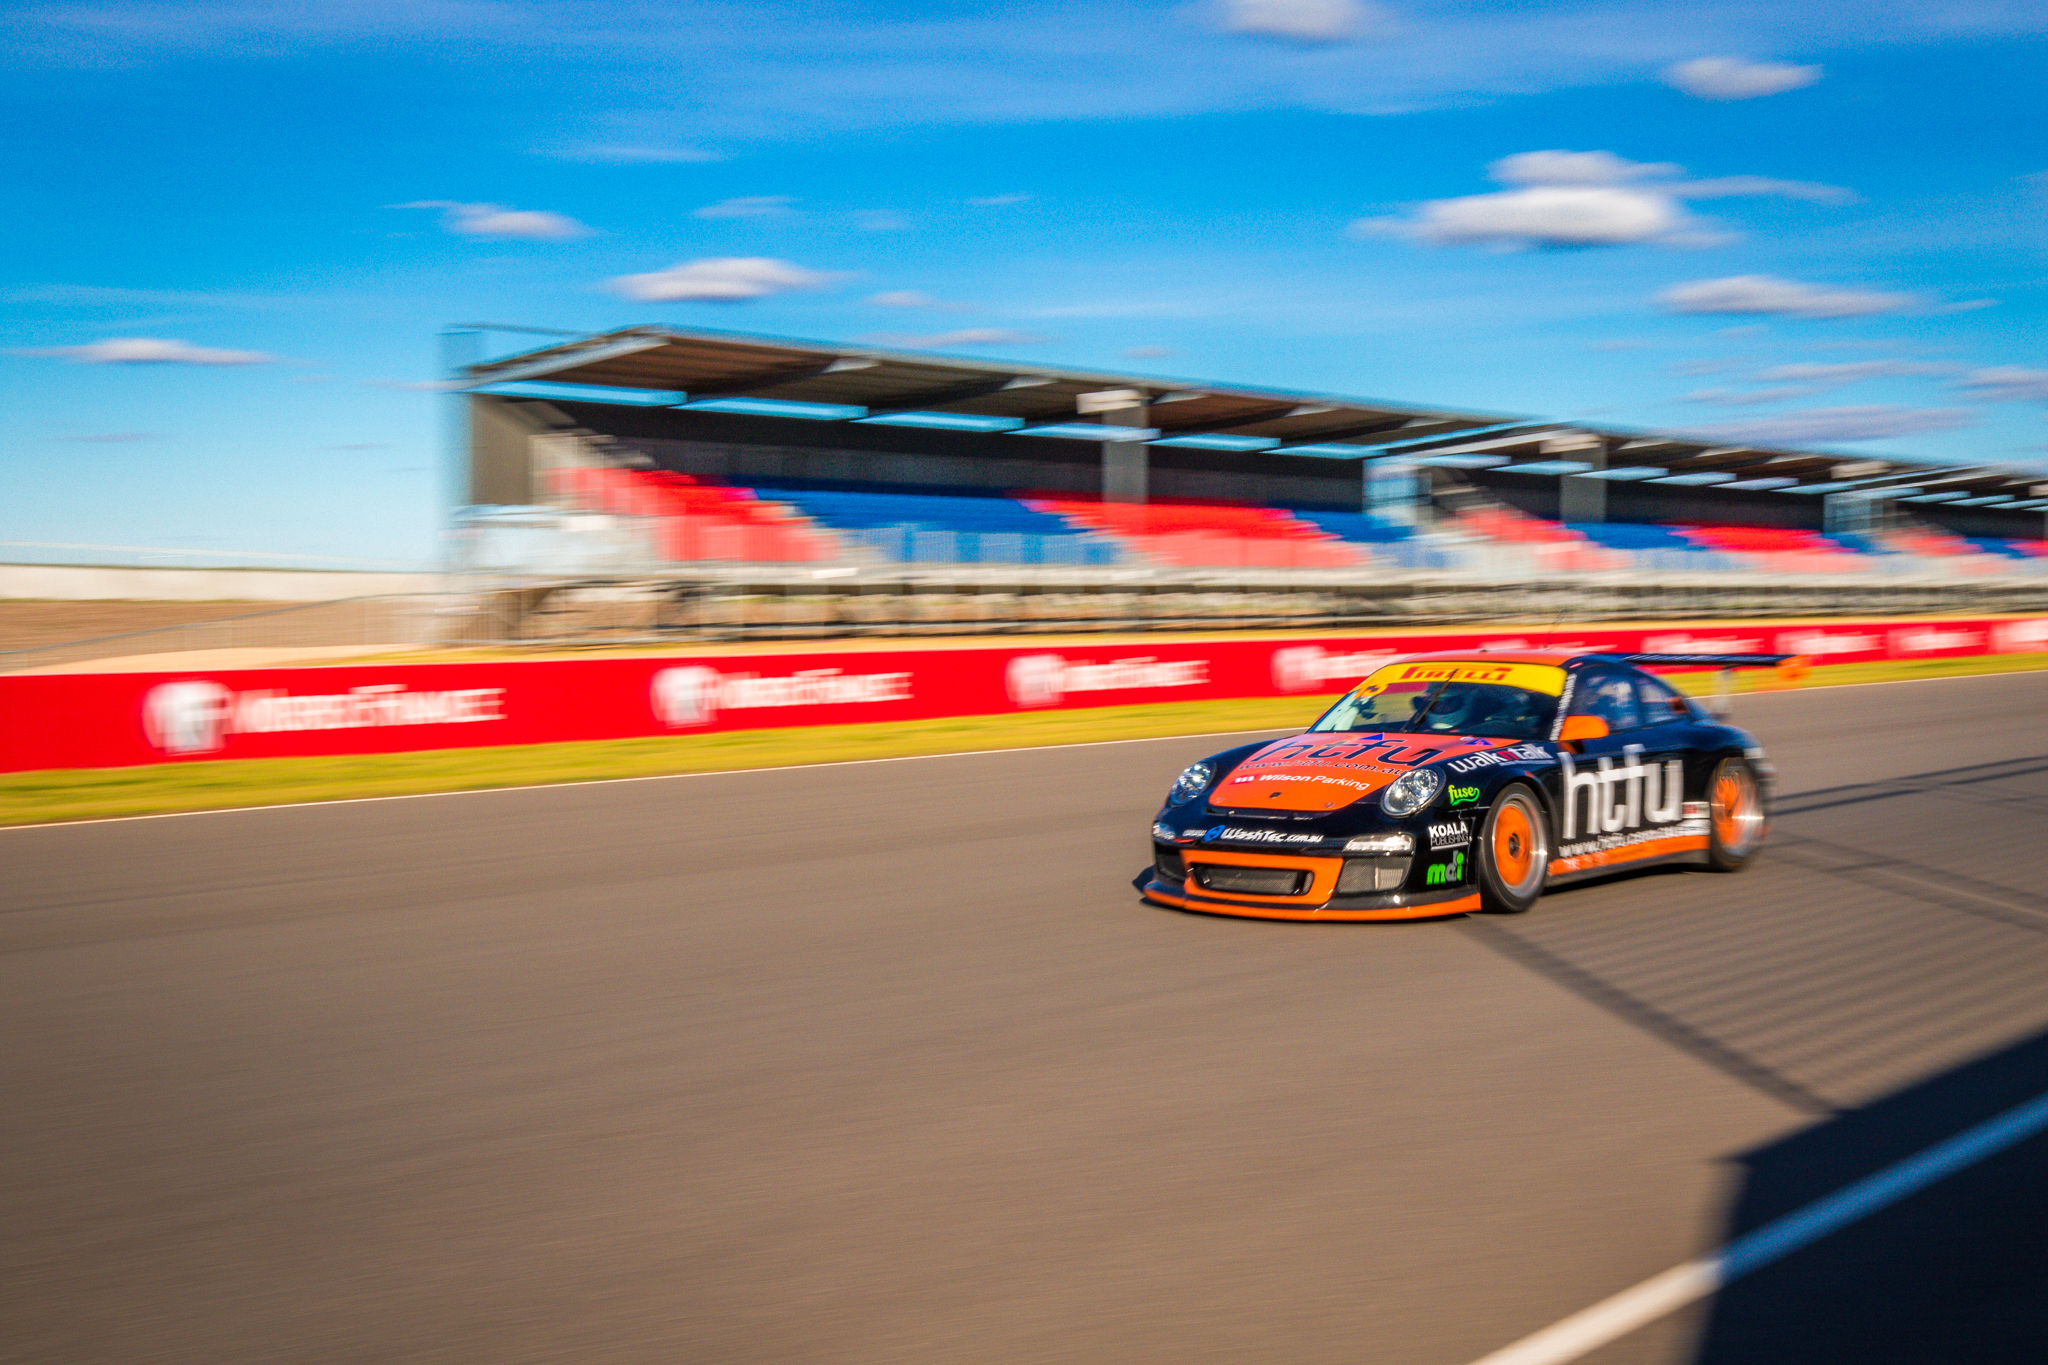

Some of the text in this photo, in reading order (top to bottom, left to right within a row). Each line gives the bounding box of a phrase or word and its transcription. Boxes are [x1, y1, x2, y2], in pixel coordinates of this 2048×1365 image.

[1399, 665, 1514, 682] PIRELLI
[1248, 738, 1446, 768] htfu
[1258, 773, 1371, 791] Wilson Parking
[1557, 743, 1685, 840] htfu
[1448, 784, 1480, 807] fuse
[1428, 820, 1469, 839] KOALA
[1430, 832, 1469, 847] PUBLISHING
[1426, 849, 1465, 885] mdi
